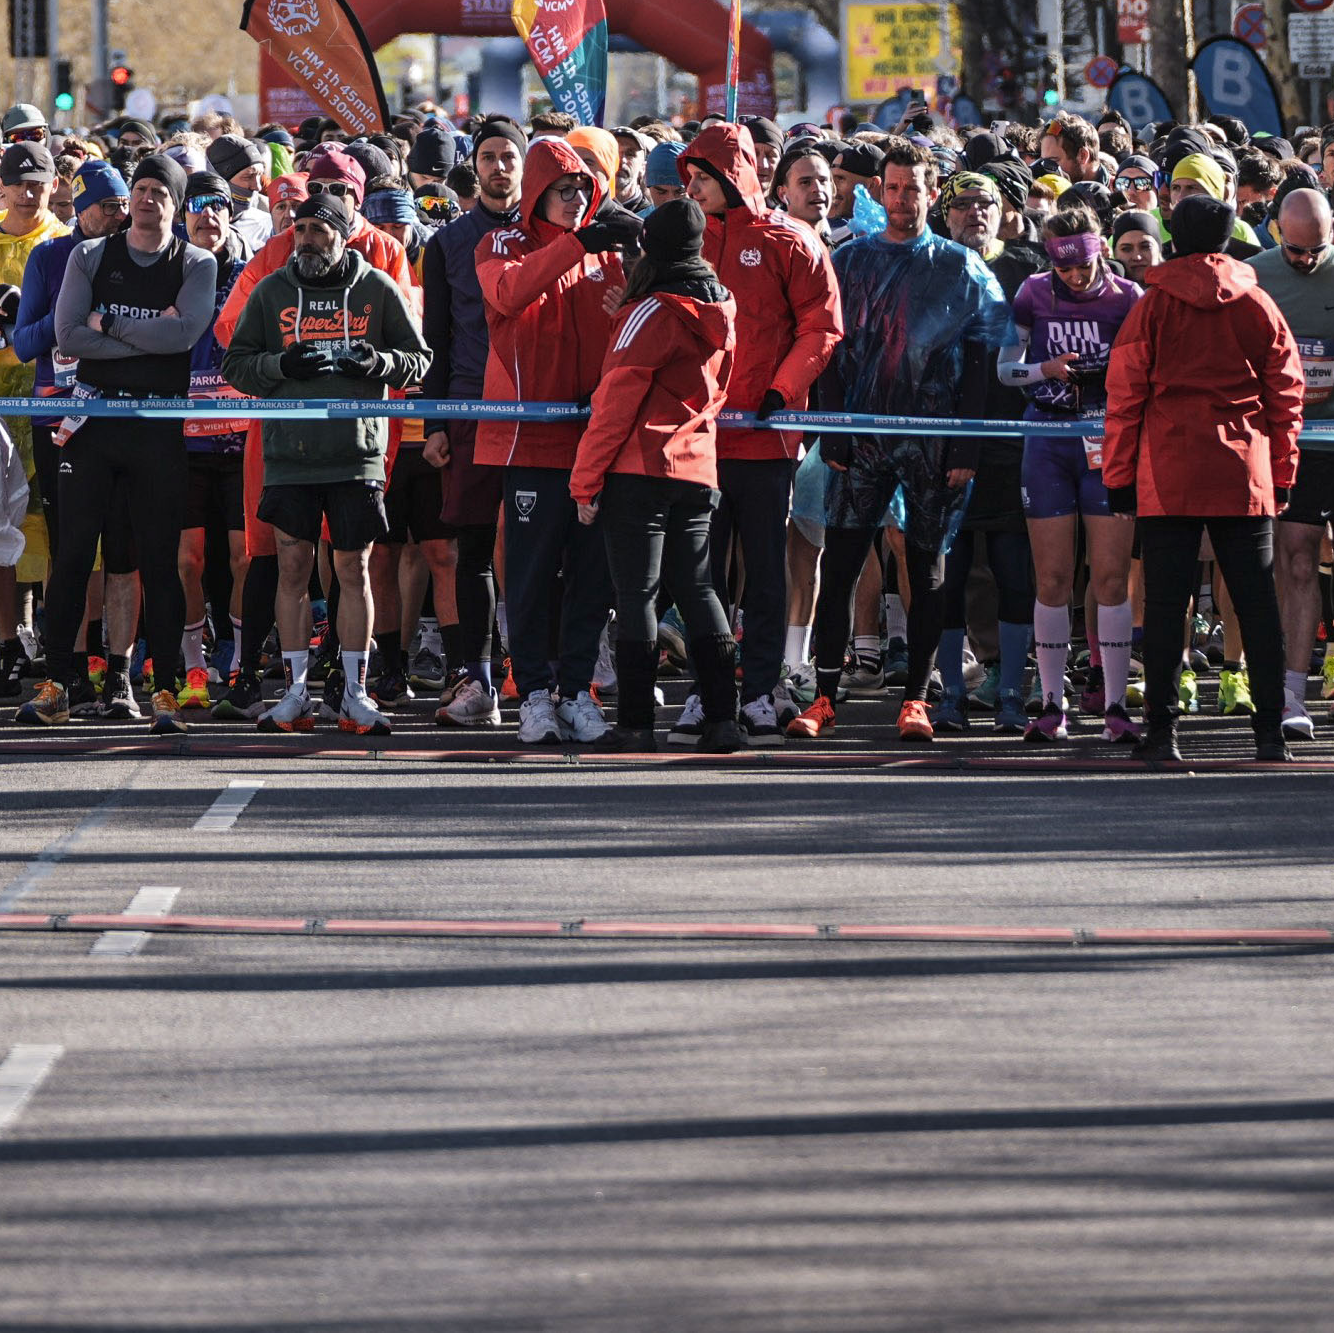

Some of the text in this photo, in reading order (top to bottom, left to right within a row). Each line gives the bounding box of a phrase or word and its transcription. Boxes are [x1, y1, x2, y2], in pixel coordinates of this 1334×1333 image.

[543, 0, 568, 12] VCM
[283, 23, 312, 37] VCM
[530, 25, 556, 65] VCM
[547, 66, 565, 89] 3h
[547, 25, 569, 56] HM
[561, 56, 578, 80] 1h
[1212, 46, 1252, 106] B
[302, 46, 378, 124] HM 1h 45min
[286, 50, 315, 81] VCM
[312, 79, 330, 98] 3h
[329, 95, 367, 134] 30min
[1120, 80, 1154, 125] B
[108, 303, 161, 320] SPORT
[309, 300, 339, 311] REAL
[1303, 367, 1333, 378] ndrew
[189, 374, 228, 387] PARKA
[31, 399, 77, 407] SPARKASSE
[107, 400, 130, 408] ERSTE
[217, 401, 240, 409] ERSTE
[361, 403, 407, 411] SPARKASSE
[547, 406, 570, 414] ERSTE
[768, 414, 845, 423] RSTE SPARKASSE
[874, 417, 955, 427] ERSTE SPARKASSE
